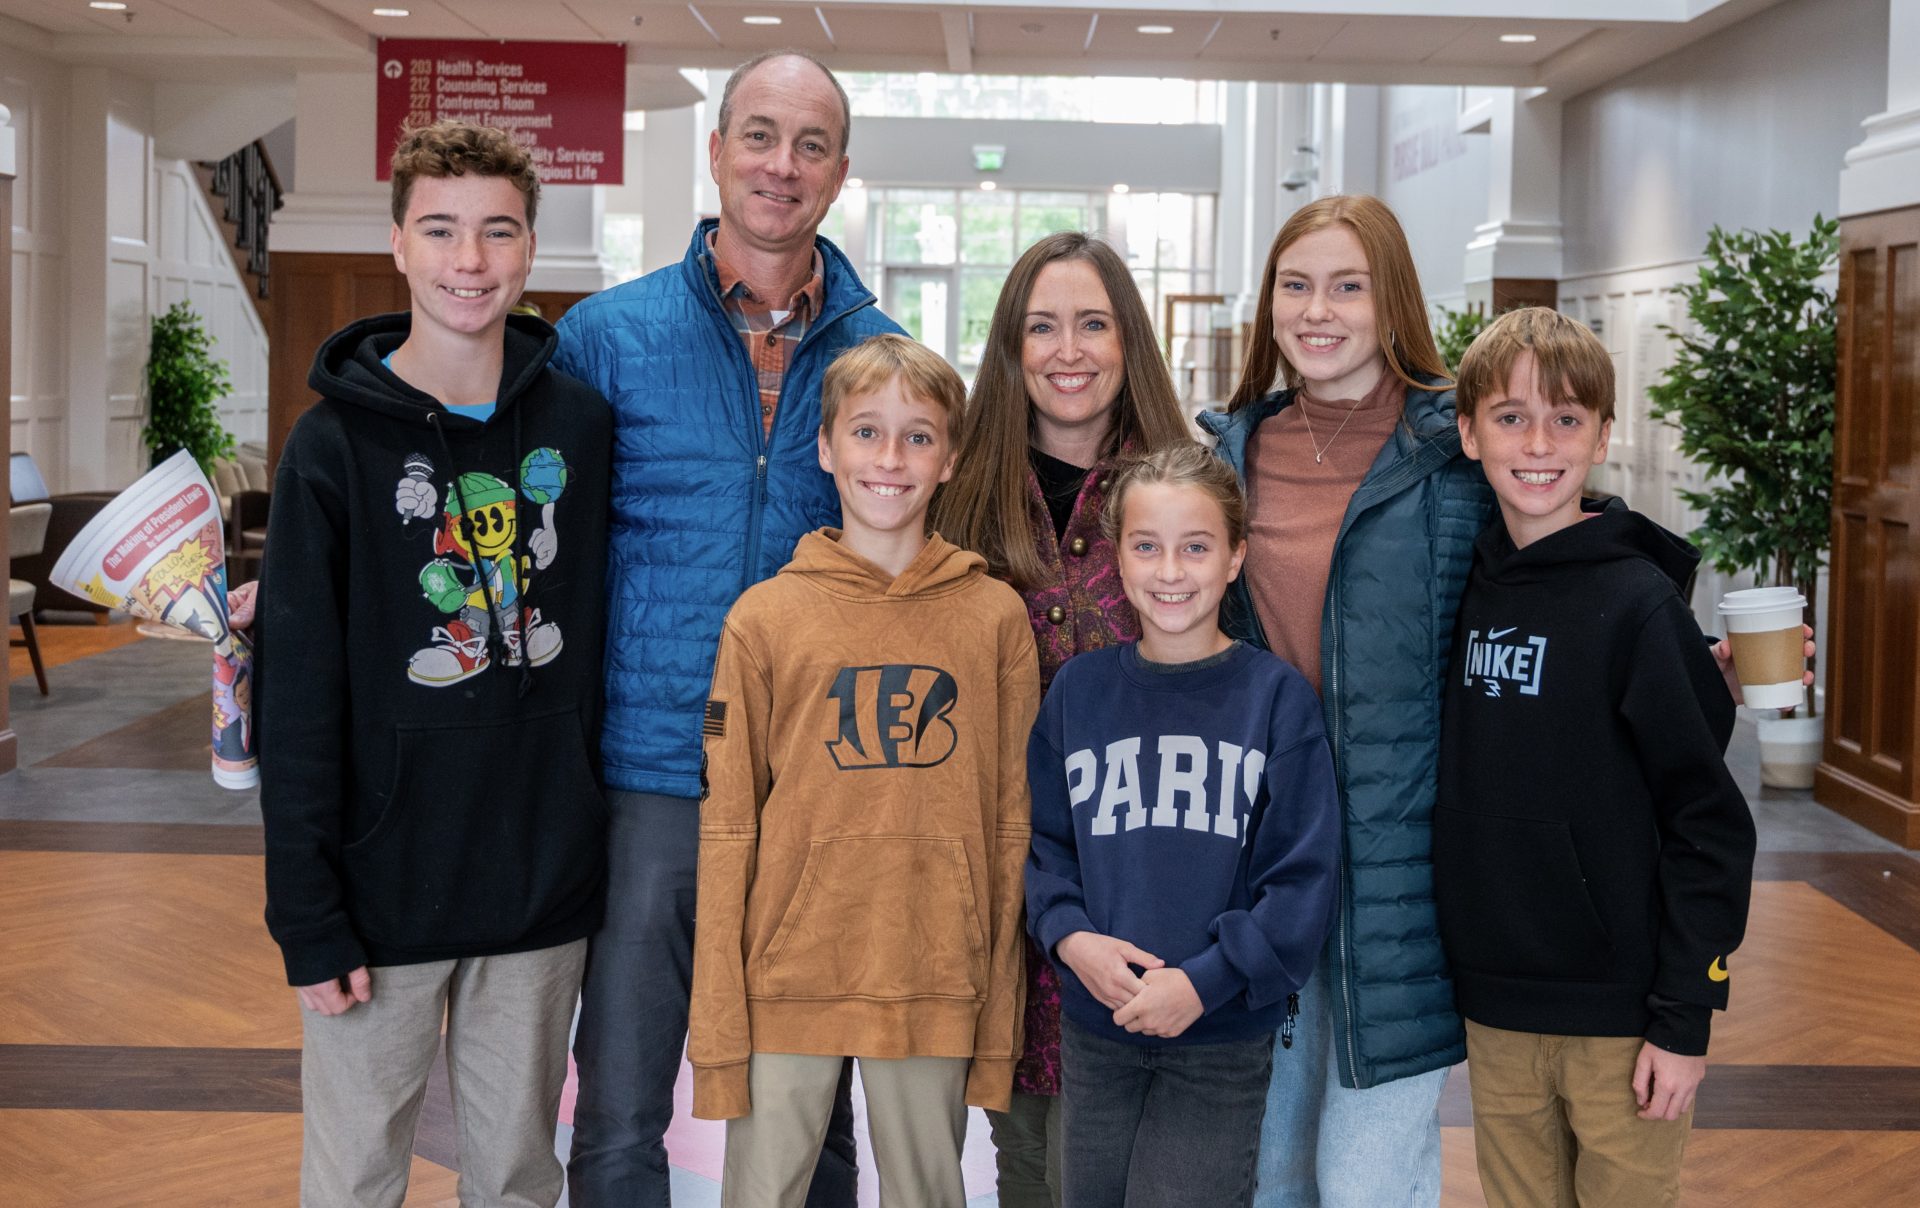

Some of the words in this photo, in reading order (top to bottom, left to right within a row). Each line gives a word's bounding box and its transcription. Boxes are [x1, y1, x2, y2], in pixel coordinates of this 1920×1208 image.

[410, 60, 431, 75] 203
[437, 61, 473, 76] Health
[476, 62, 523, 77] Services
[410, 77, 430, 92] 212
[437, 78, 497, 96] Counseling
[500, 78, 547, 94] Services
[410, 94, 431, 109] 227
[437, 94, 500, 110] Conference
[503, 95, 534, 111] Room
[483, 112, 552, 130] Engagement
[557, 146, 605, 163] Services
[576, 164, 598, 180] Life
[106, 553, 122, 569] The
[116, 529, 148, 559] Making
[143, 521, 155, 536] of
[150, 498, 188, 528] President
[182, 487, 204, 505] Lewis
